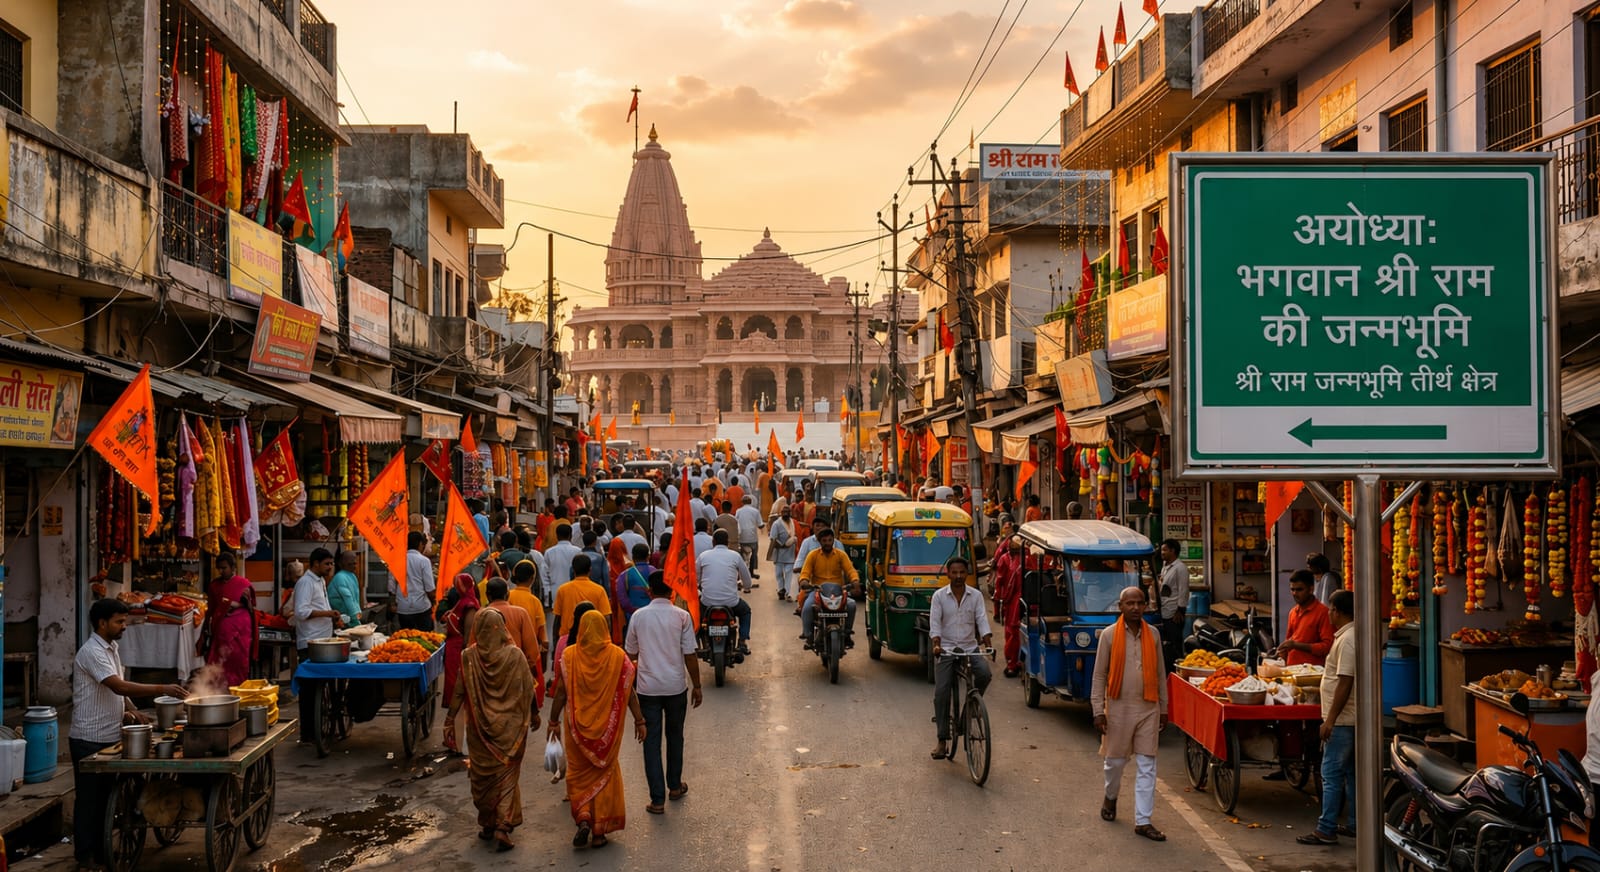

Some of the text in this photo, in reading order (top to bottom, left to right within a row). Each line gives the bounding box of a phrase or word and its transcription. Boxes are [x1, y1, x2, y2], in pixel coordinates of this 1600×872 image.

[988, 148, 1013, 168] श्री
[1015, 153, 1049, 168] राम
[1293, 202, 1436, 246] अयोध्या:
[1236, 253, 1495, 297] भगवान श्री राम
[1260, 303, 1472, 360] की जन्मभूमि
[1235, 364, 1499, 399] श्री राम जन्मभूमि तीर्थ क्षेत्र
